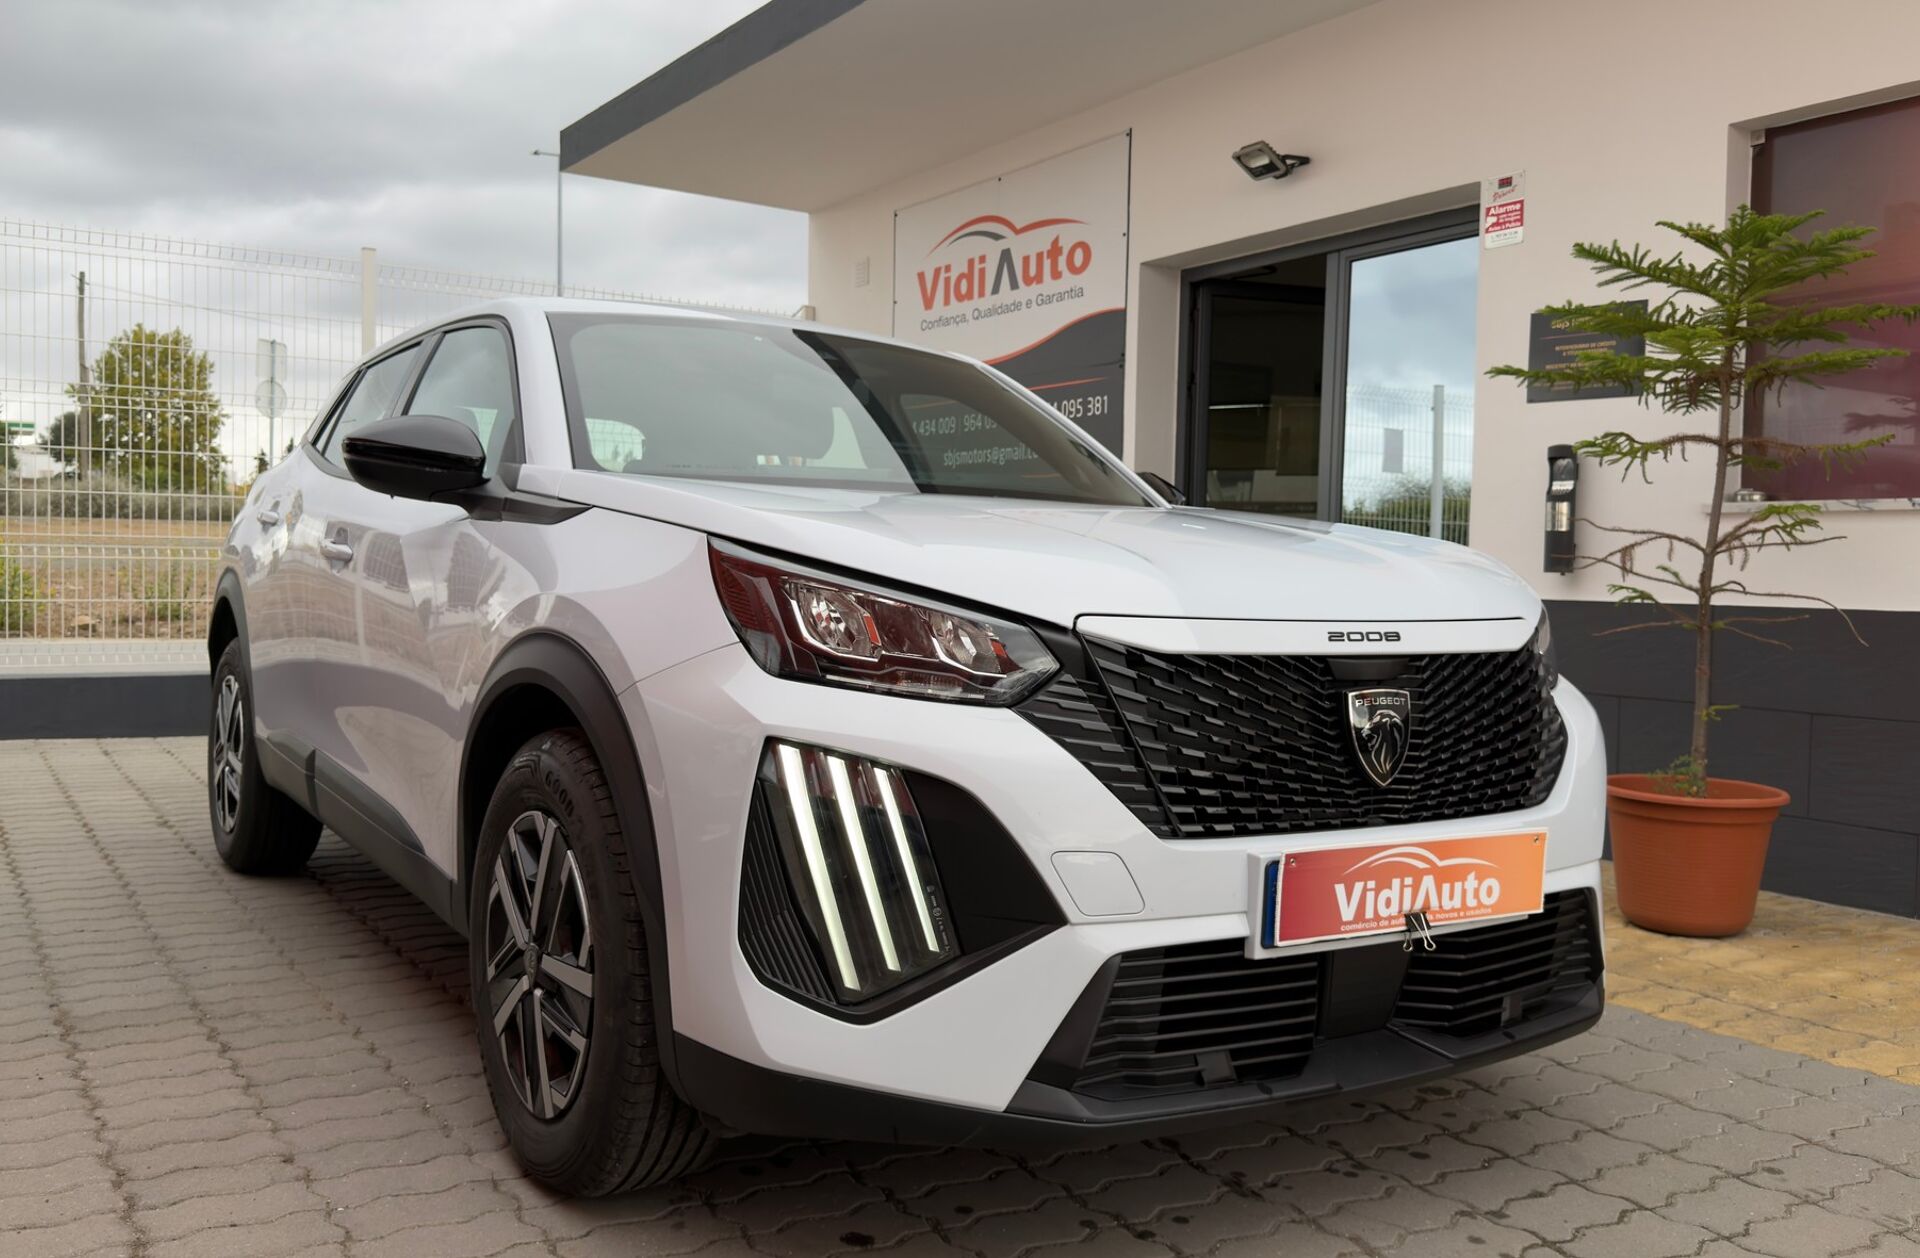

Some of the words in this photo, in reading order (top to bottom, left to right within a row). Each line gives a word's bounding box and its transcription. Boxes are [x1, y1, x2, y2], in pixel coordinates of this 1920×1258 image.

[1488, 203, 1522, 216] Alarme
[917, 234, 1092, 311] VidiAuto
[920, 313, 970, 332] Confiança,
[971, 299, 1023, 321] Qualidade
[1025, 298, 1033, 309] e
[1035, 286, 1084, 307] Garantia
[1061, 398, 1083, 418] 095
[1086, 395, 1109, 416] 381
[918, 419, 937, 436] 434
[937, 416, 957, 434] 009
[963, 413, 983, 432] 964
[1327, 631, 1402, 642] 2008
[1355, 697, 1406, 707] PEUGEOT
[1334, 871, 1501, 921] VidiAuto
[1340, 921, 1378, 931] comércio
[1379, 919, 1390, 928] de
